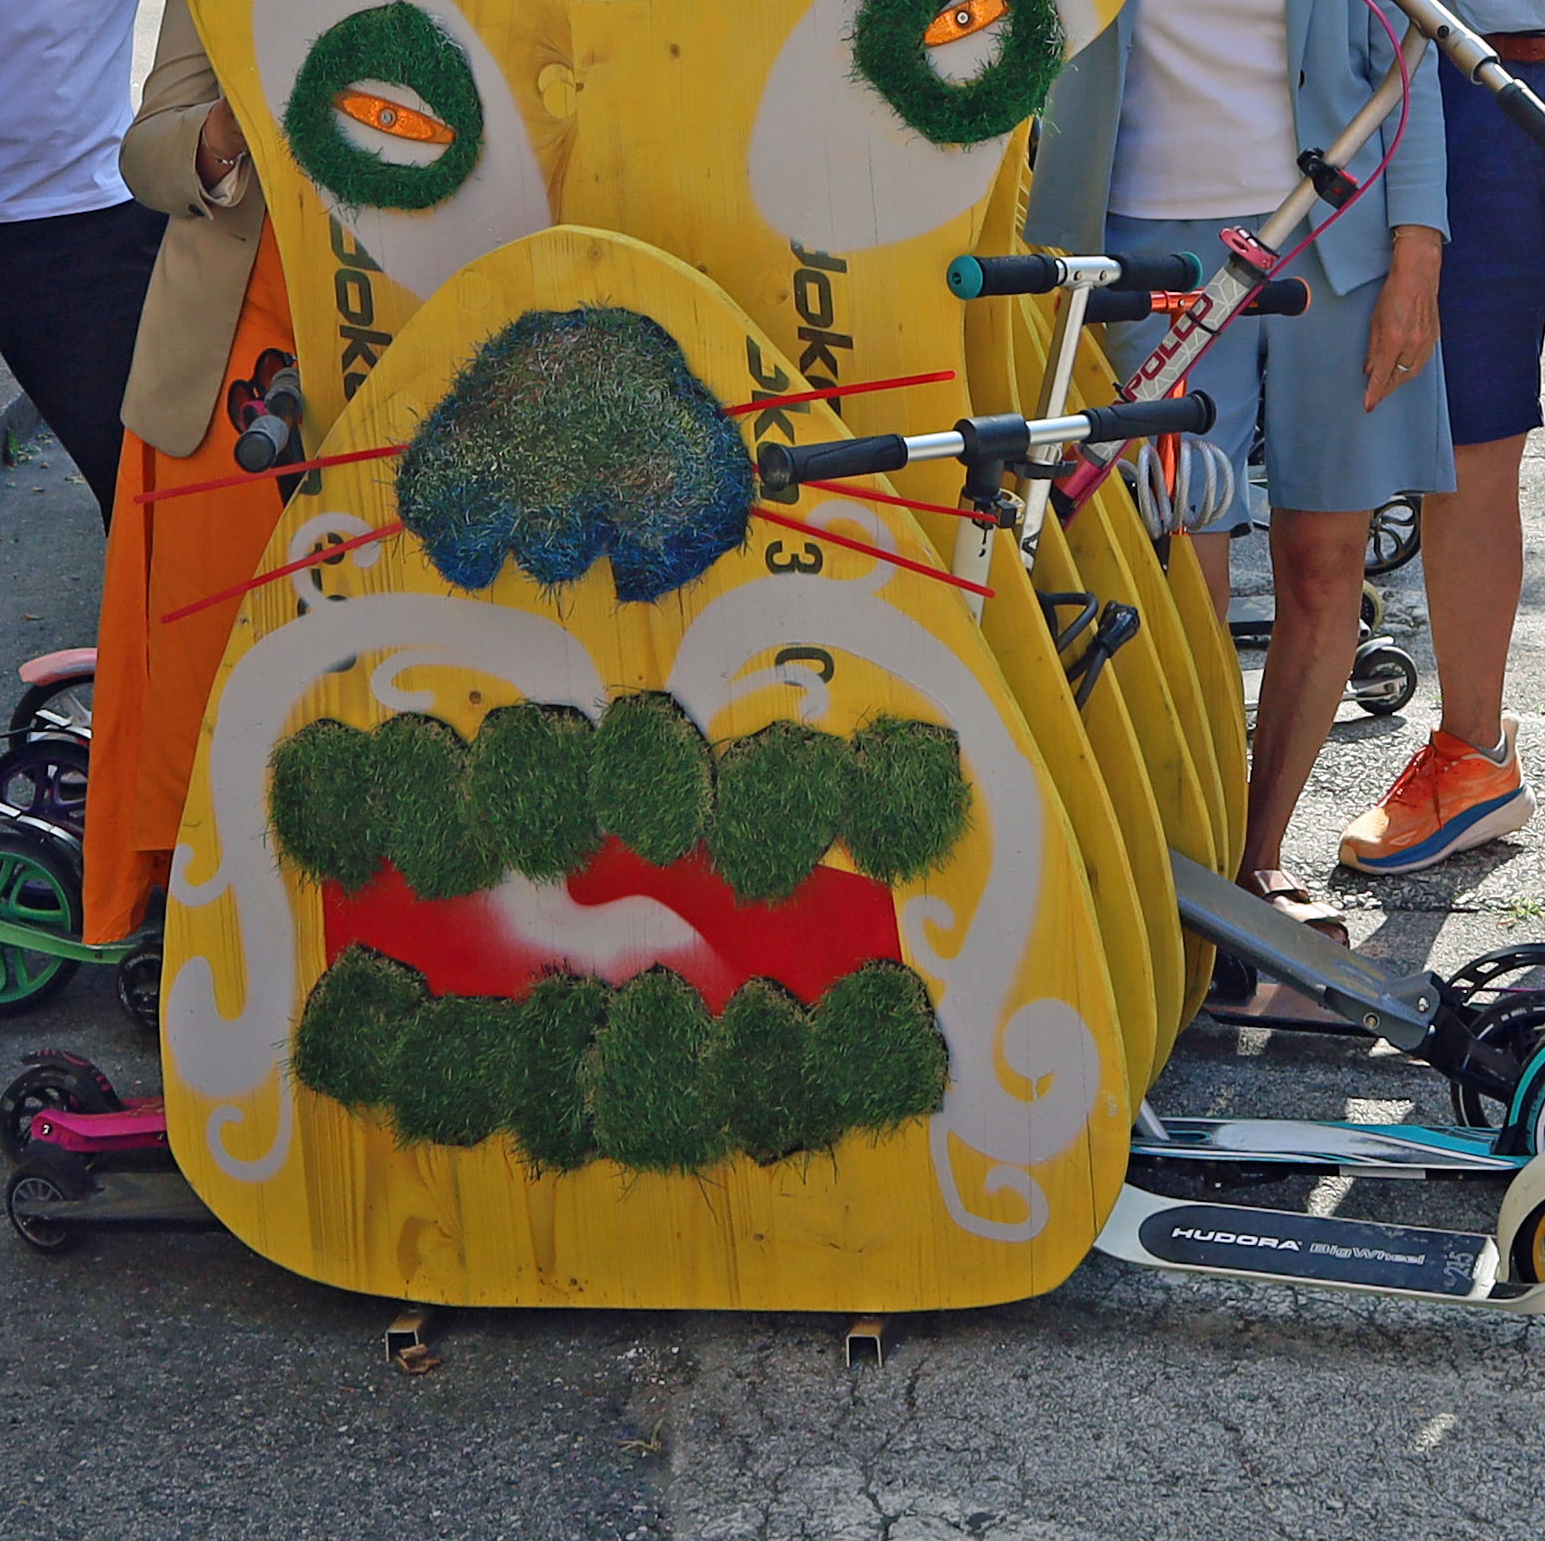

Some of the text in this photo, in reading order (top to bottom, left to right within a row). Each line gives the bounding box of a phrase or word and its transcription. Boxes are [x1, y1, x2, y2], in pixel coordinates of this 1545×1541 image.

[1111, 294, 1214, 406] POLLO
[1171, 1227, 1426, 1266] HUDORA BigWheel
